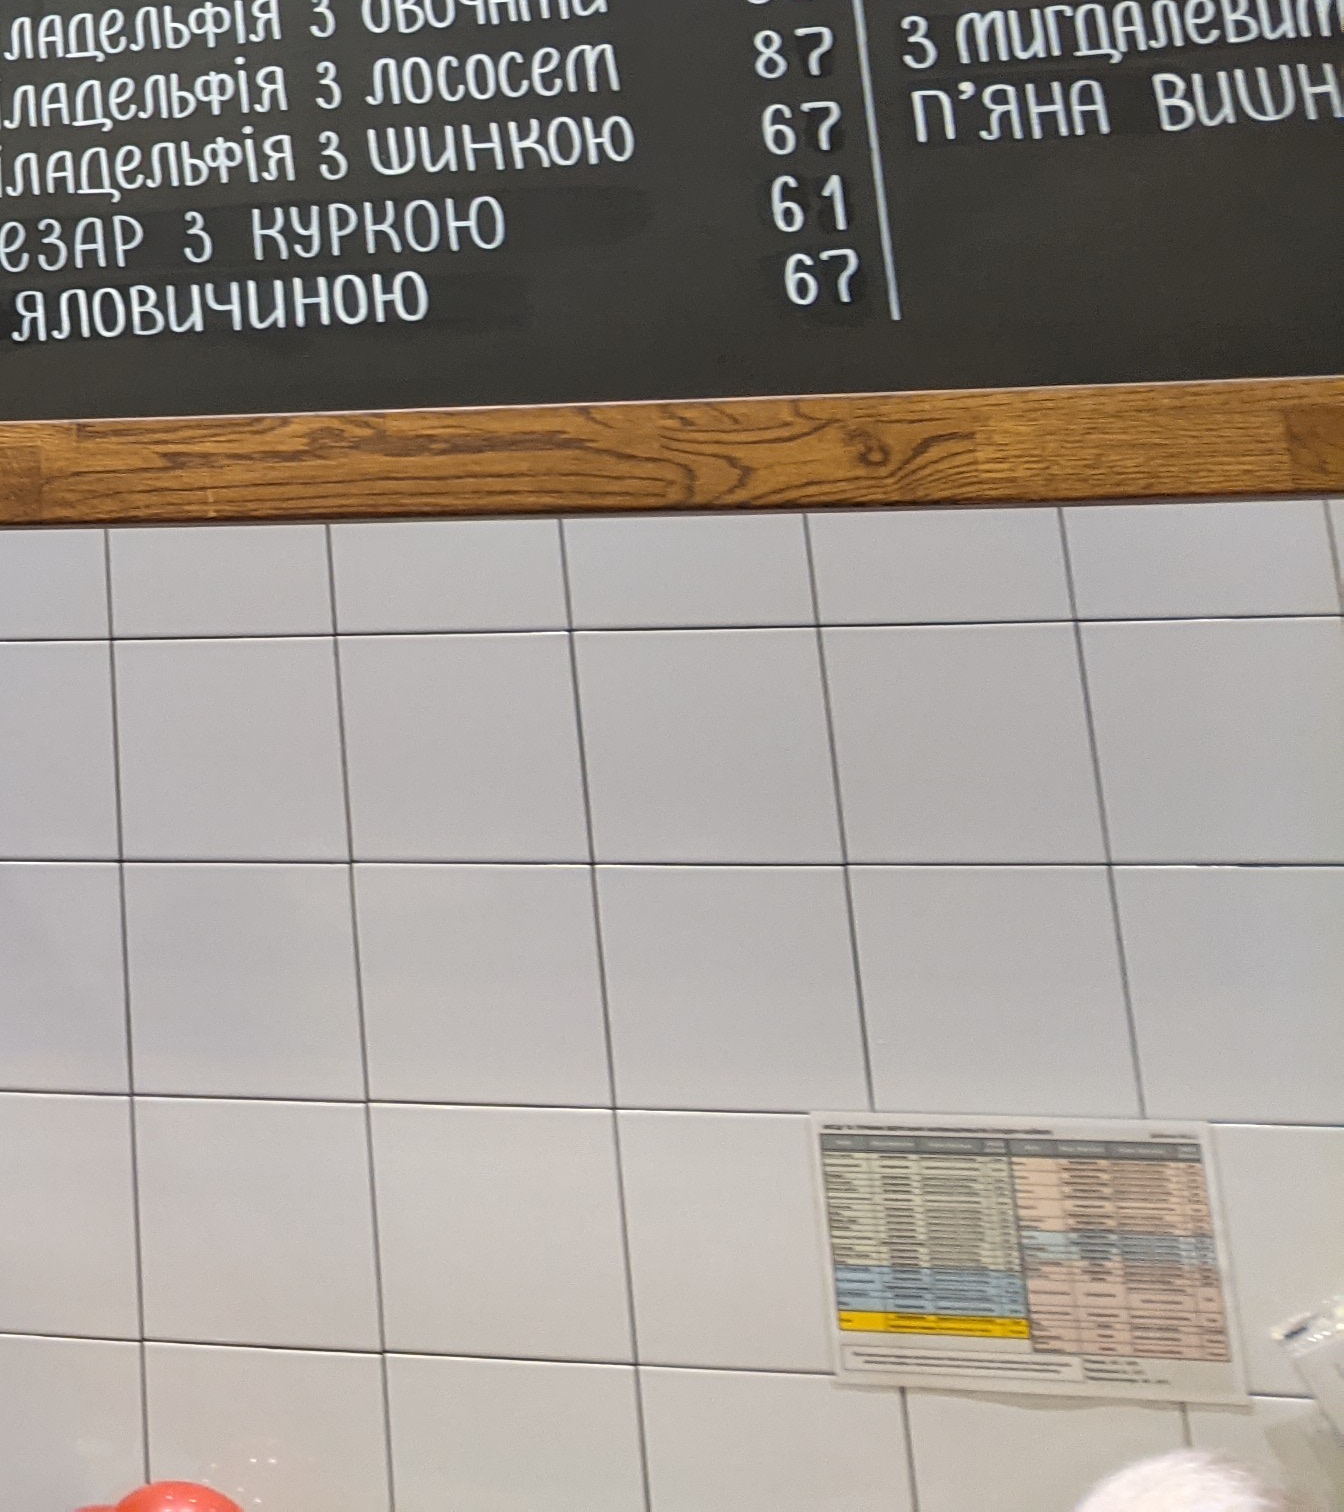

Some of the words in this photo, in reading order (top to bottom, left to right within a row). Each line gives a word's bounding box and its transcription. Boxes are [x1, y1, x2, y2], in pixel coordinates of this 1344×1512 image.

[753, 26, 833, 79] 87
[365, 115, 636, 178] ШИНКОЮ
[251, 195, 505, 261] КУРКОЮ
[771, 174, 848, 233] 61
[11, 270, 429, 342] ЯЛОВИЧИНОЮ
